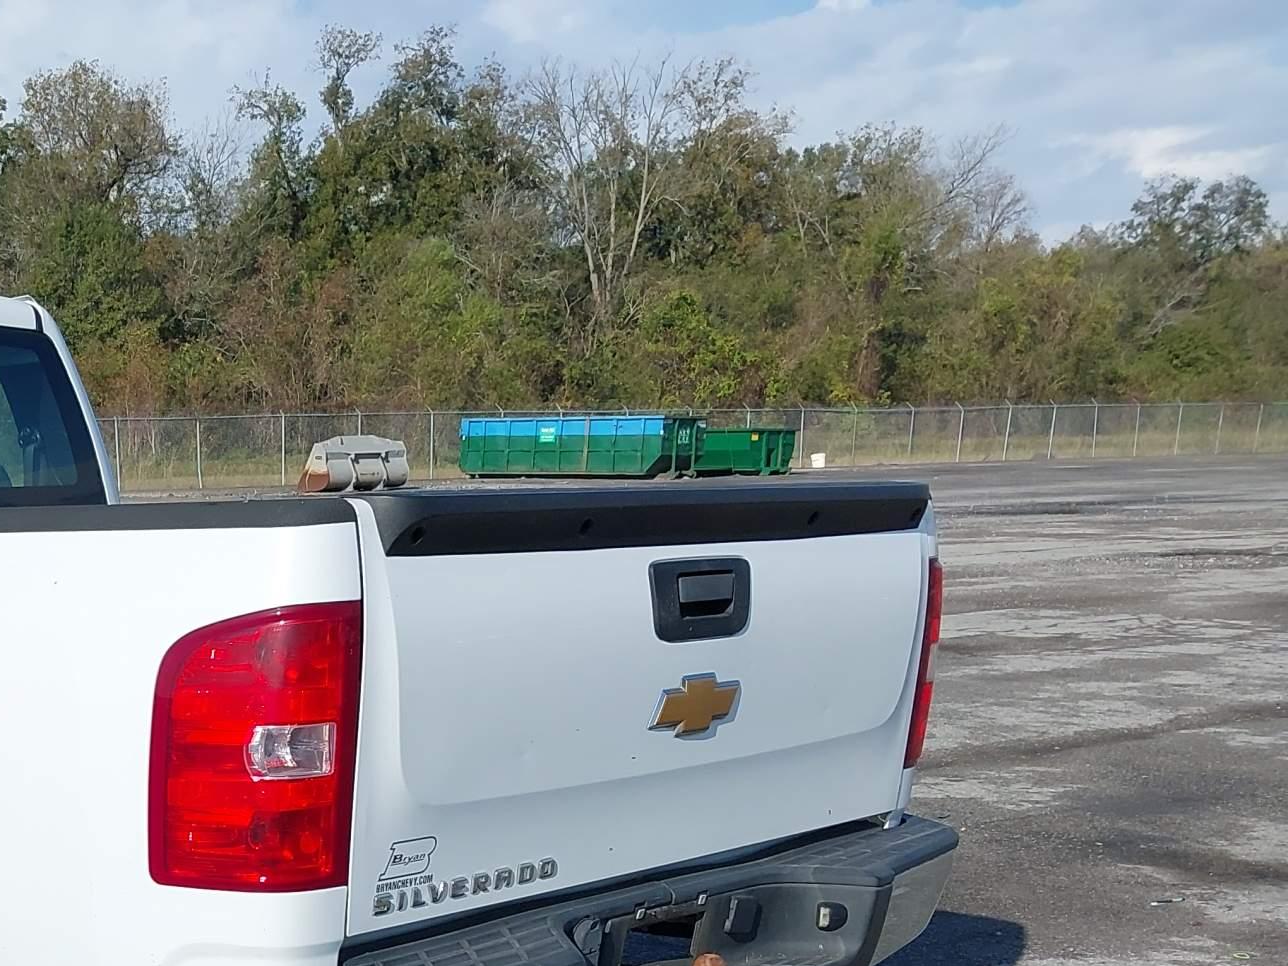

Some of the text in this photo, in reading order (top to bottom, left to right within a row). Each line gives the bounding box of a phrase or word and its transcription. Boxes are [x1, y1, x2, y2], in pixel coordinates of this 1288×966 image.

[391, 851, 426, 866] Bryan
[372, 857, 559, 917] SILVERADO
[375, 873, 434, 894] BRYANCHEVY.COM
